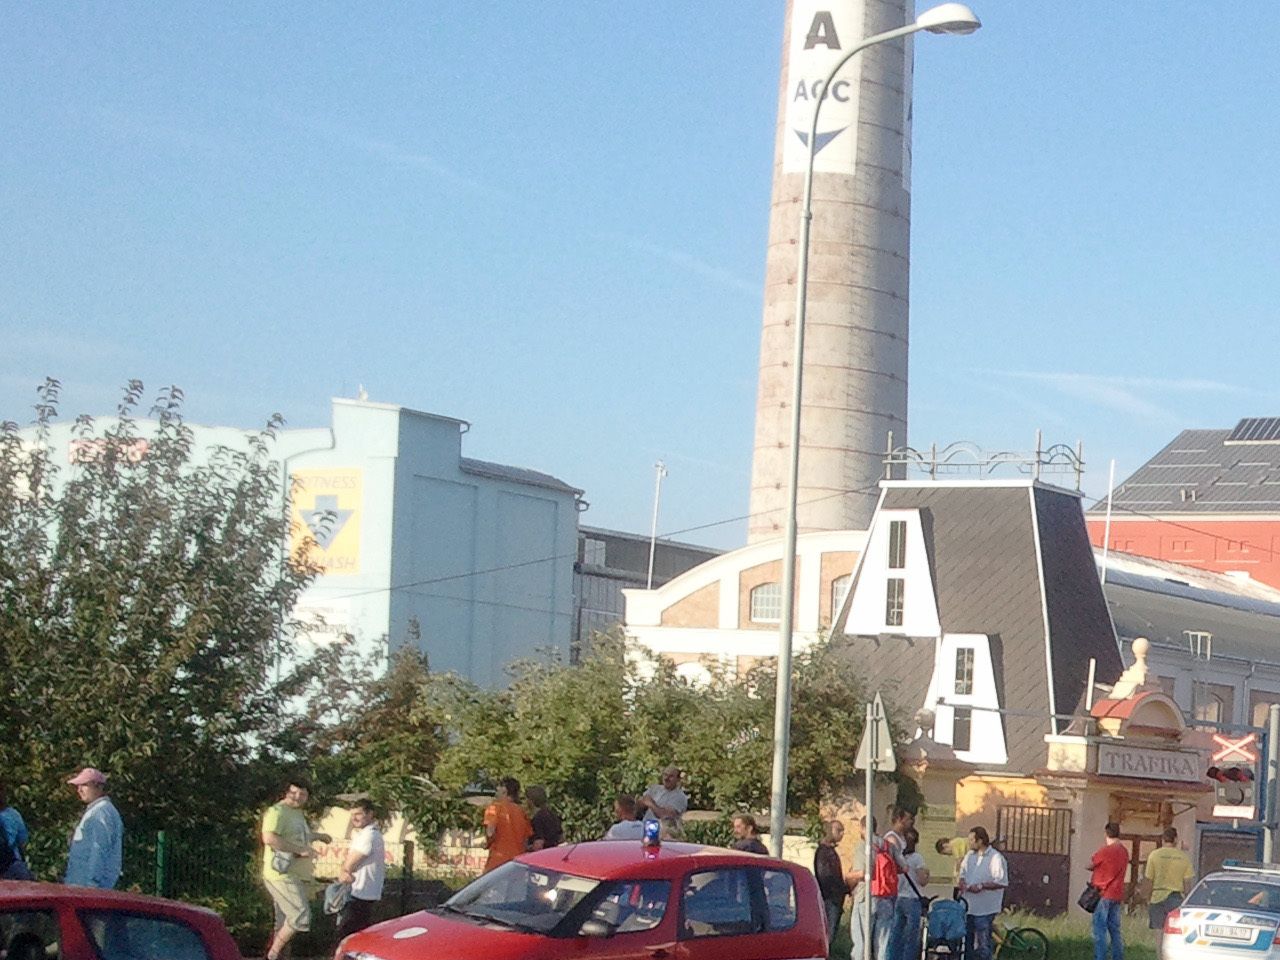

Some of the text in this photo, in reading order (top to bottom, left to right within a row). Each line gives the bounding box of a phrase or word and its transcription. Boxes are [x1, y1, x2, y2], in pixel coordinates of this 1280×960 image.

[803, 11, 842, 50] A
[793, 79, 851, 102] AGC
[1105, 751, 1195, 776] TRAFIKA
